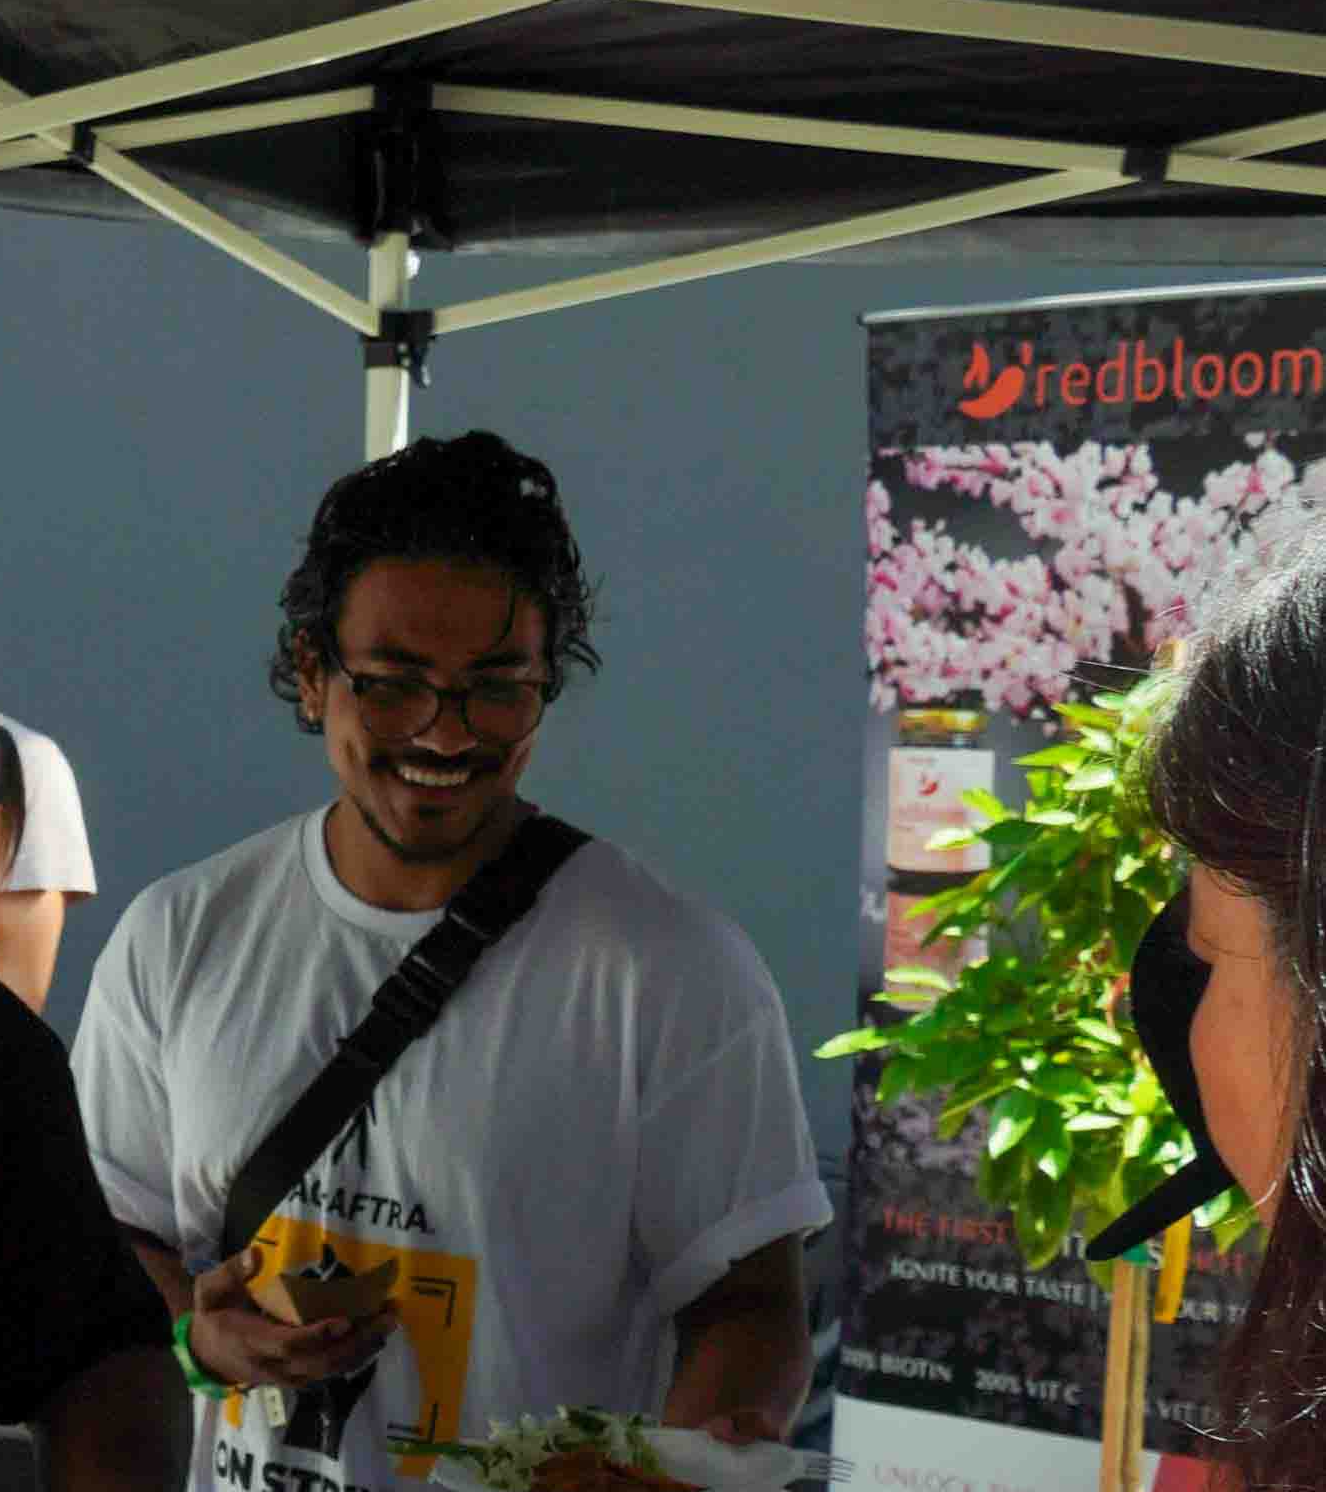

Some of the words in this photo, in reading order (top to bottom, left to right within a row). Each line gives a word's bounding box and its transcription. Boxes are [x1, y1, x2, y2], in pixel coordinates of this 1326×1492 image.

[1033, 337, 1324, 406] redbloom
[890, 1258, 963, 1288] IGNITE
[966, 1269, 1019, 1297] YOUR
[1024, 1276, 1085, 1307] TASTE
[879, 1352, 952, 1383] BIOTIN
[214, 1441, 253, 1492] ON
